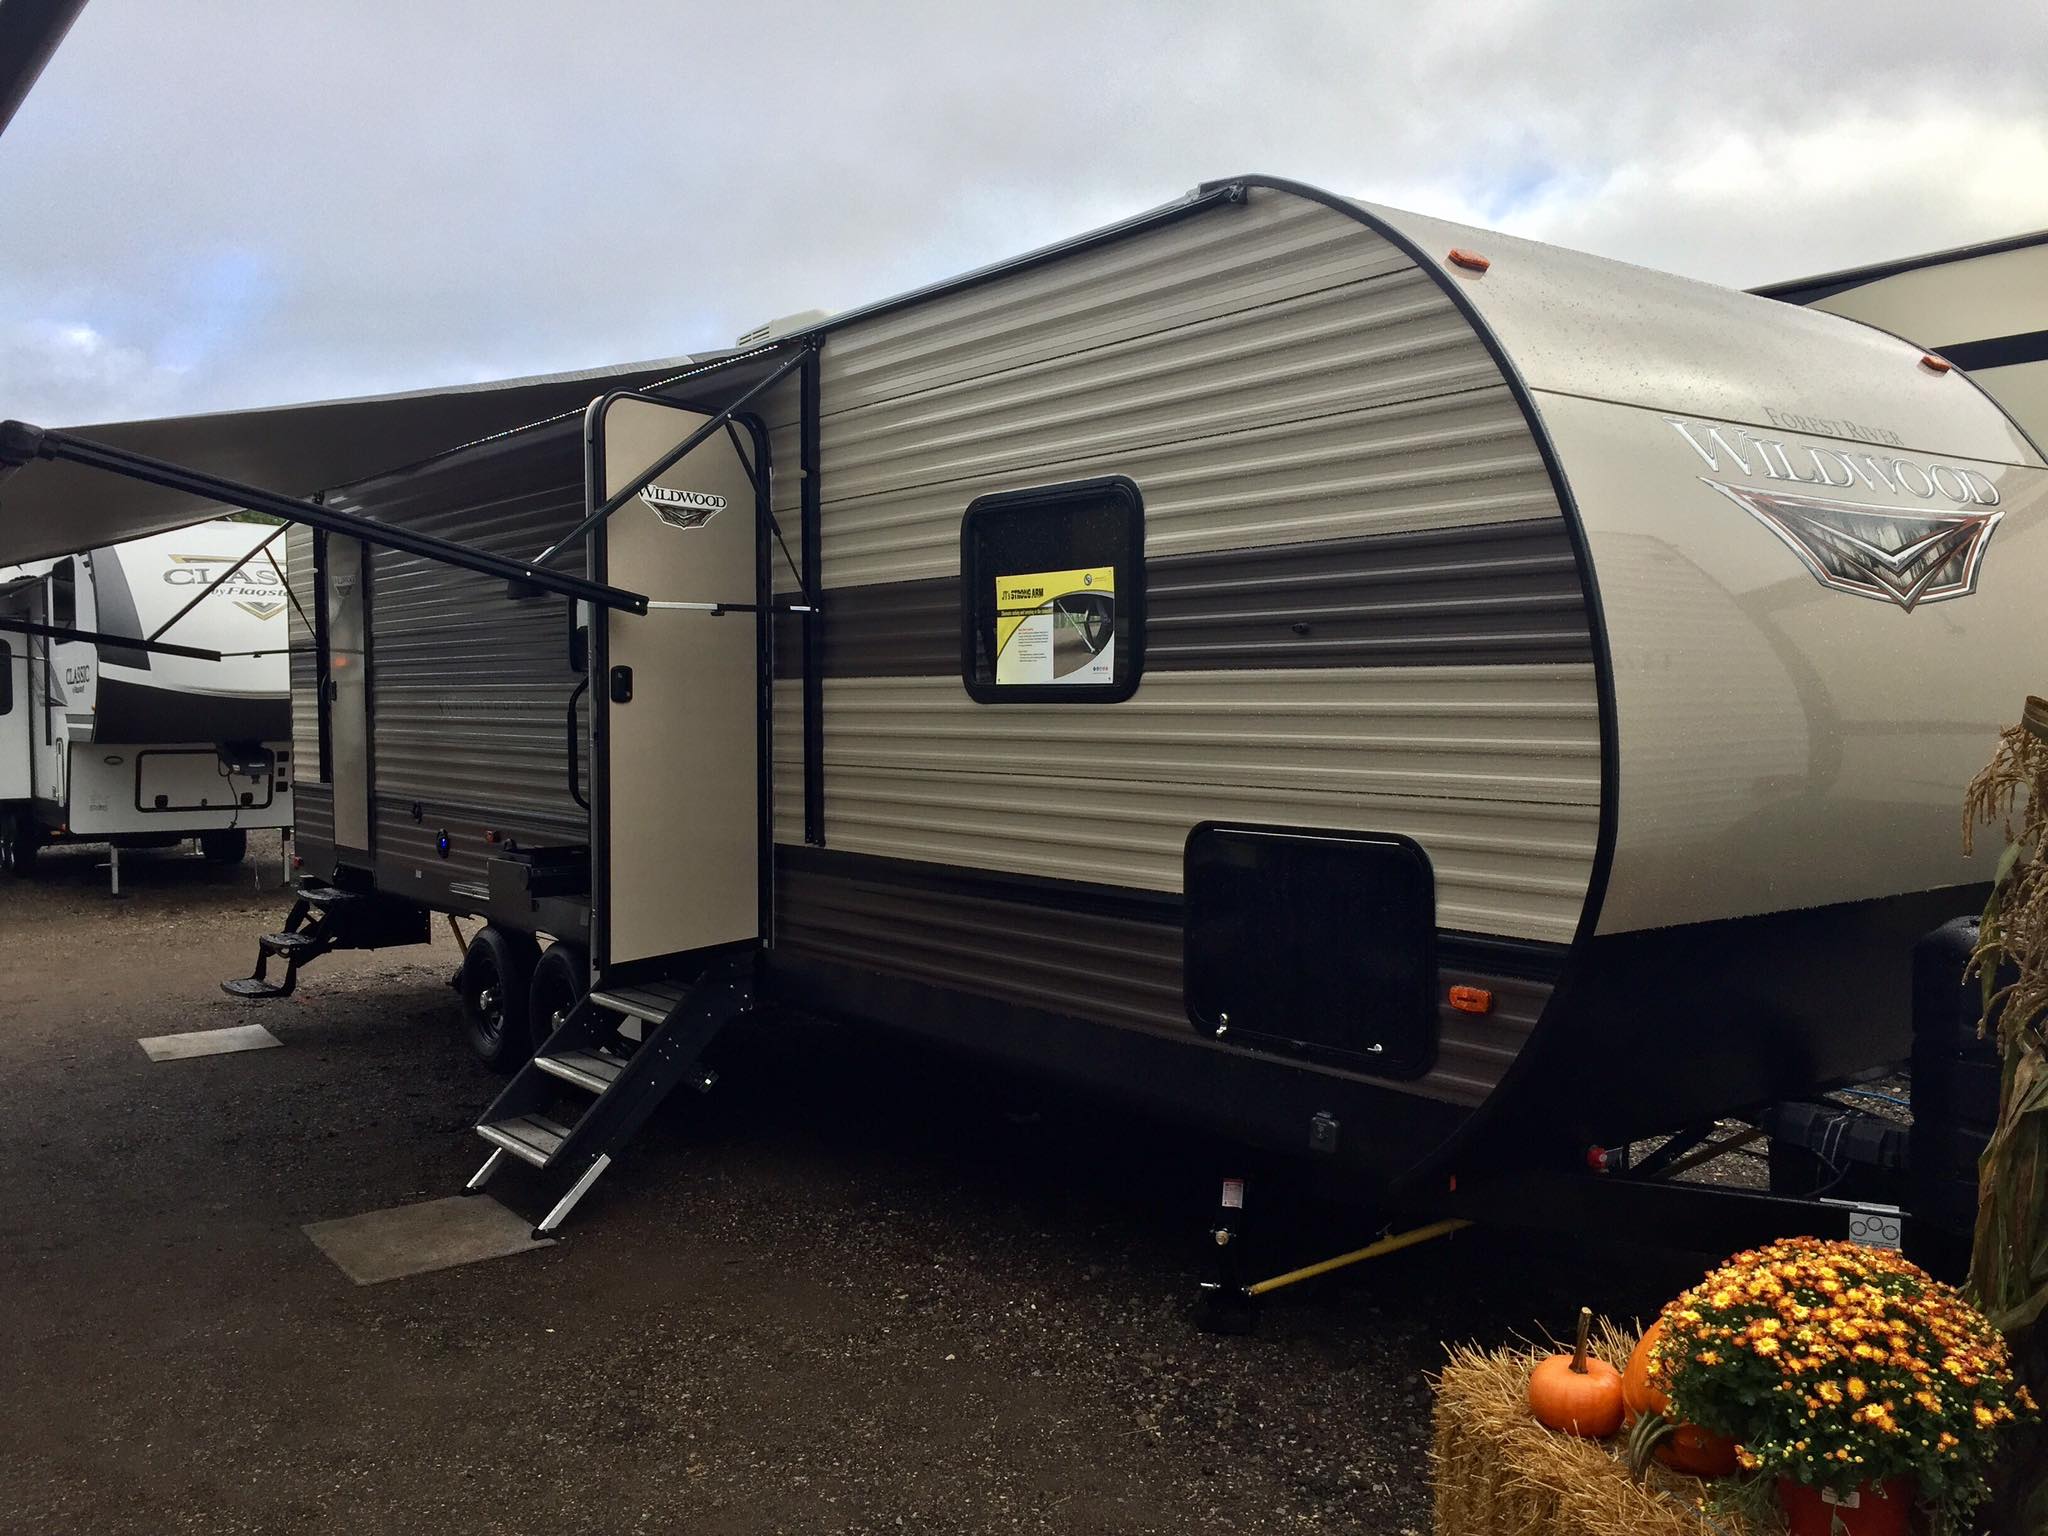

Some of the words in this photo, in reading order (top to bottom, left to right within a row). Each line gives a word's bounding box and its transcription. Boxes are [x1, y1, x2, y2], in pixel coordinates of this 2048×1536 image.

[1762, 406, 1844, 437] FOREST
[1845, 422, 1904, 447] RIVER
[1662, 416, 2002, 506] WILDWOOD
[639, 485, 727, 508] WILDWOOD
[162, 568, 287, 586] CLAS
[65, 664, 90, 685] CLASSIC
